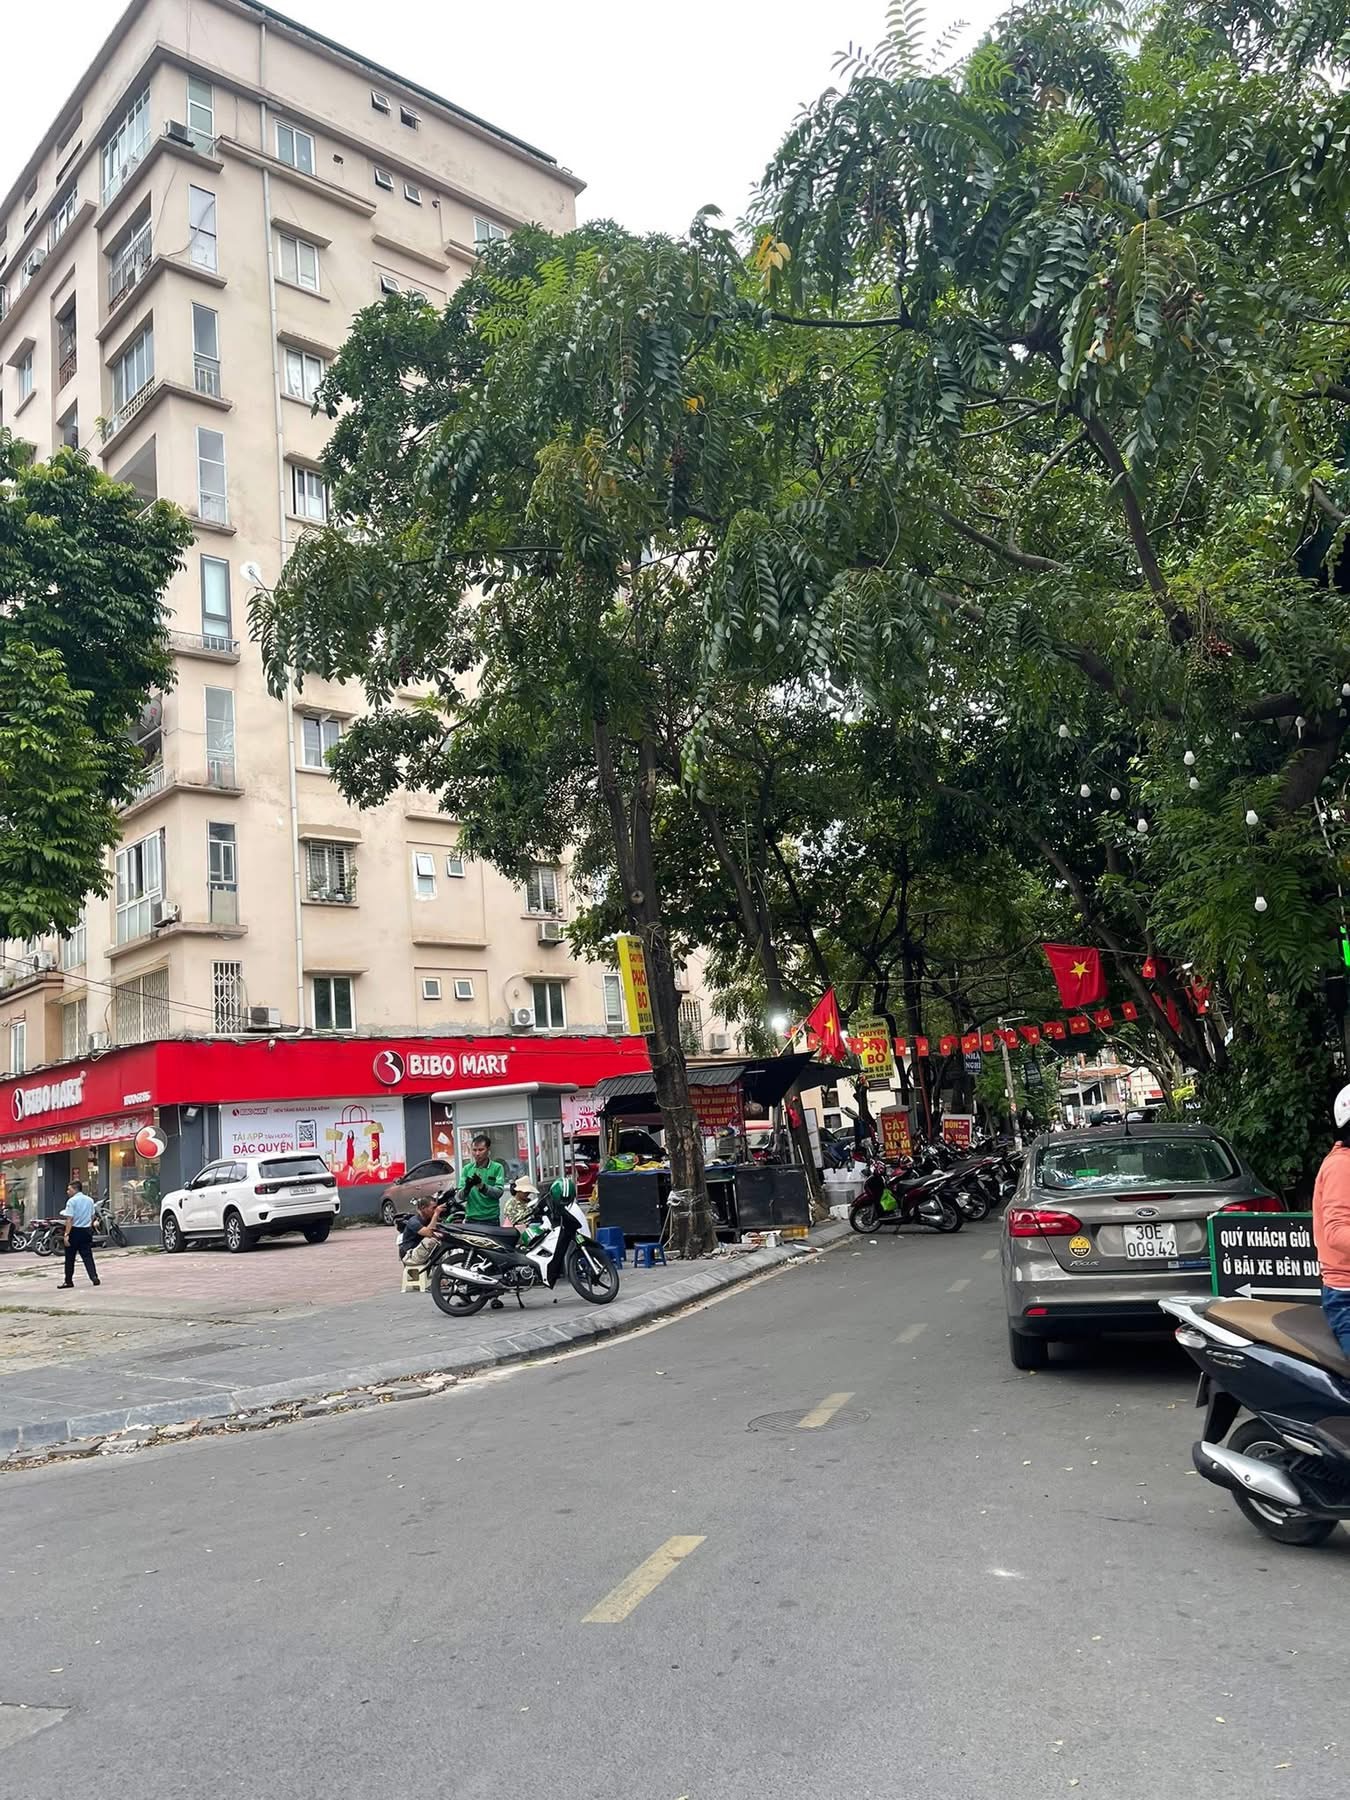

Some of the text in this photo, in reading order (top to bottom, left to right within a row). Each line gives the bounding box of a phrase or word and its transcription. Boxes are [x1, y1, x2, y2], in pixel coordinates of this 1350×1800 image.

[409, 1054, 508, 1076] BIBO MART
[1135, 1224, 1164, 1240] 30E
[1220, 1226, 1244, 1248] QUÝ
[1246, 1226, 1287, 1248] KHÁCH
[1127, 1240, 1176, 1257] 009.42
[1234, 1255, 1255, 1275] BÃI
[1256, 1259, 1273, 1275] XE
[1276, 1256, 1301, 1276] BÊN
